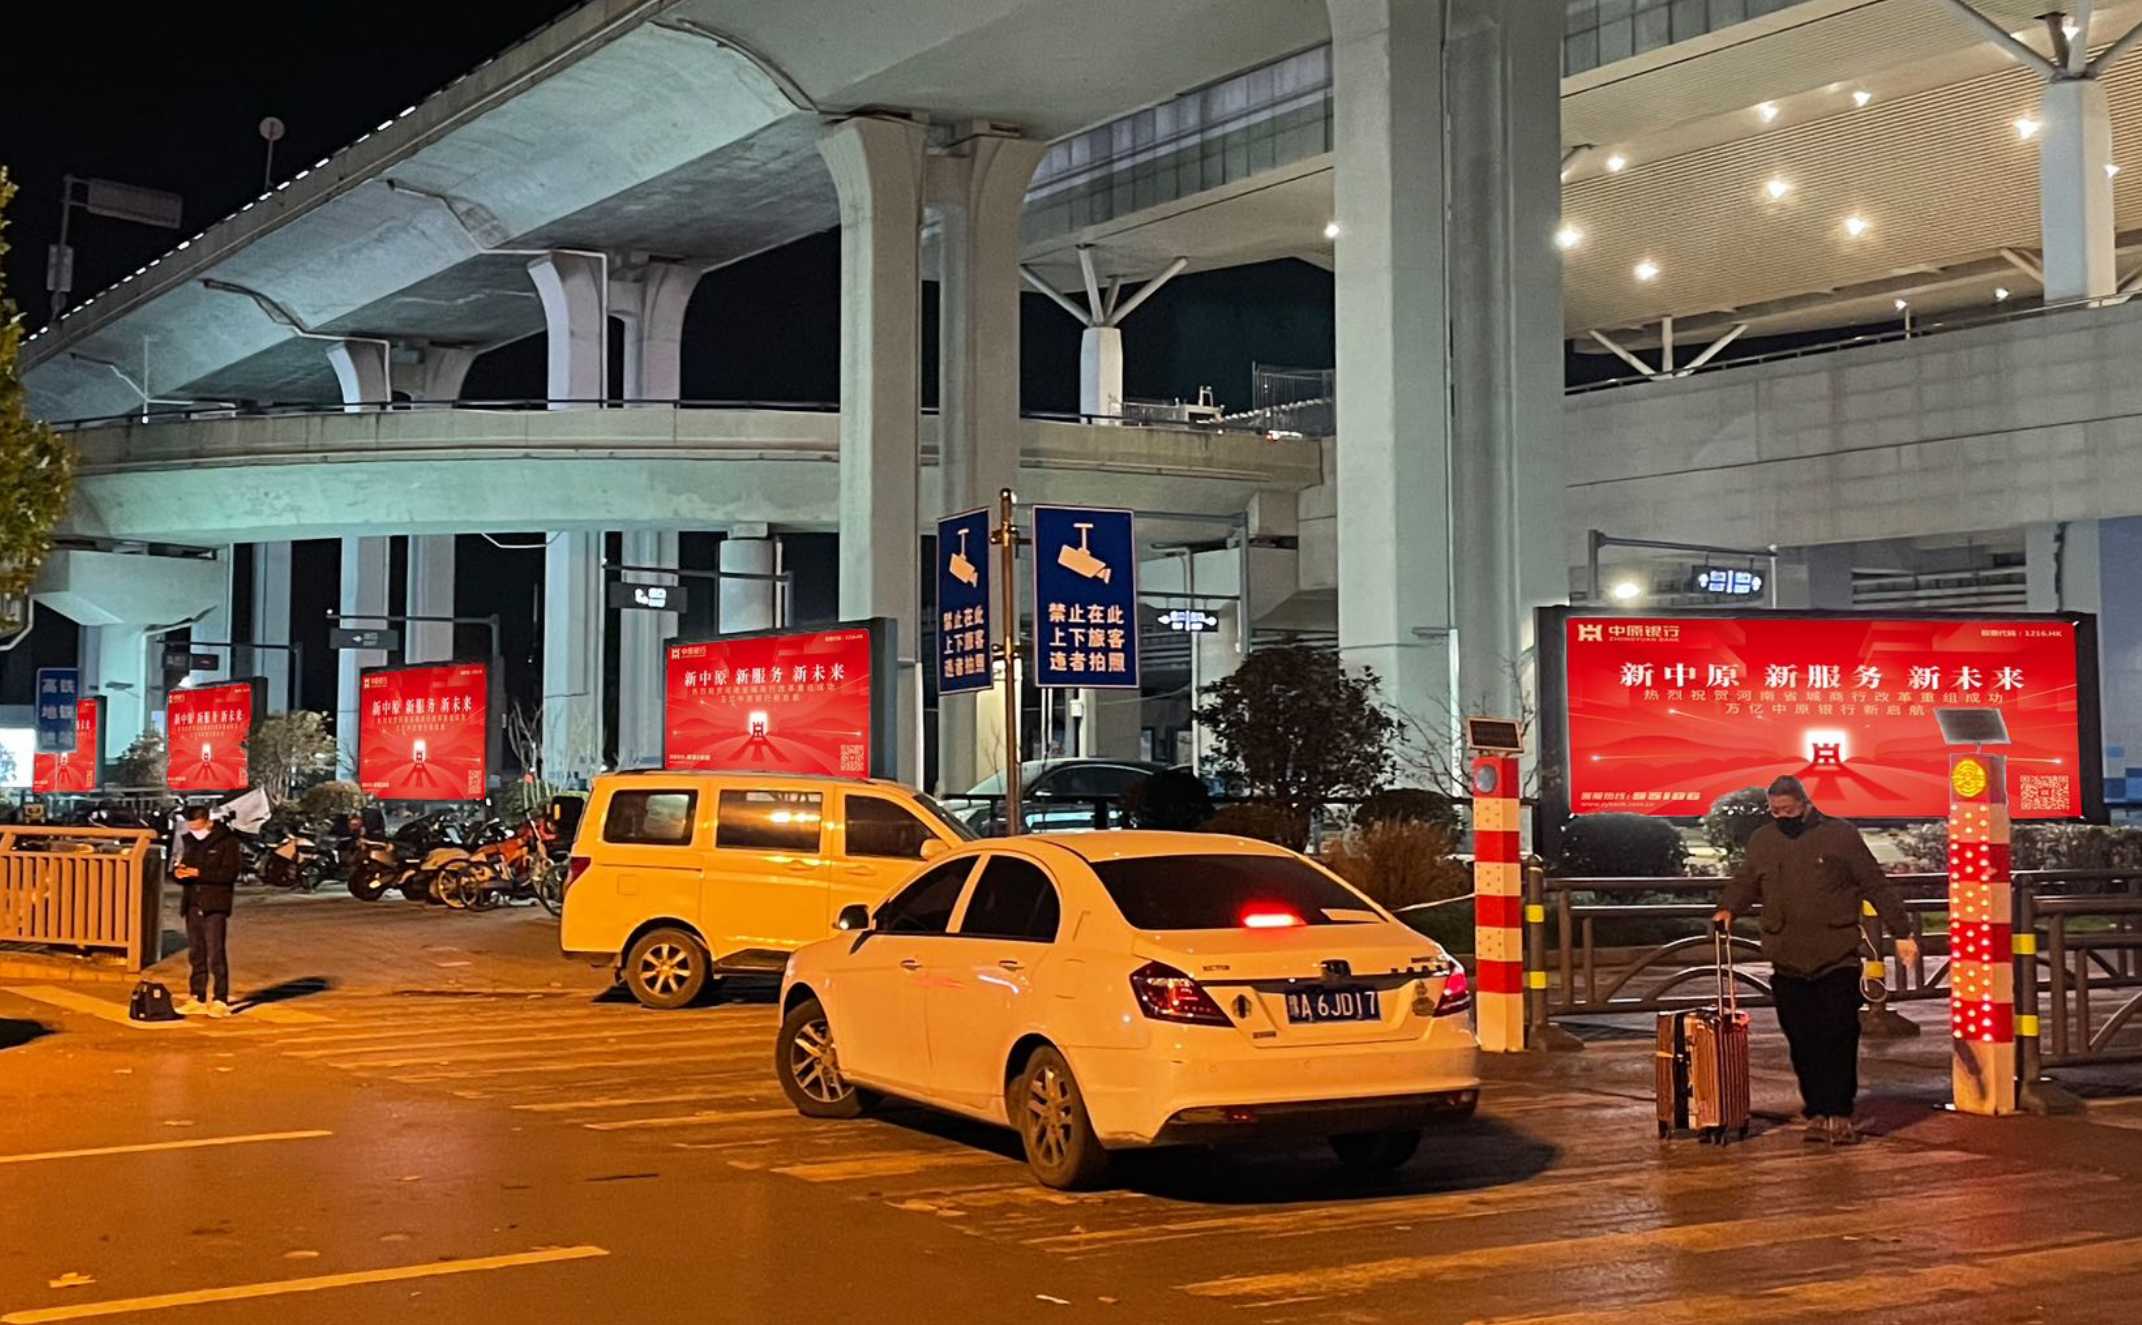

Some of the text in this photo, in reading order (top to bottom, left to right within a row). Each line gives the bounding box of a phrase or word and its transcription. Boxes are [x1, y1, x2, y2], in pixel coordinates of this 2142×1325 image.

[1048, 603, 1125, 625] 禁止在此
[1049, 627, 1126, 648] 上下旅客
[1608, 624, 1681, 637] 中原银行
[1049, 651, 1127, 673] 违者拍照
[684, 663, 846, 687] 新中原 新服务 新未来
[1619, 662, 2025, 691] 新中原 新服务 新未来
[1643, 690, 2003, 705] 热烈祝贺河南省城商行改革重组成功
[1726, 703, 1926, 717] 万亿中原银行新启航
